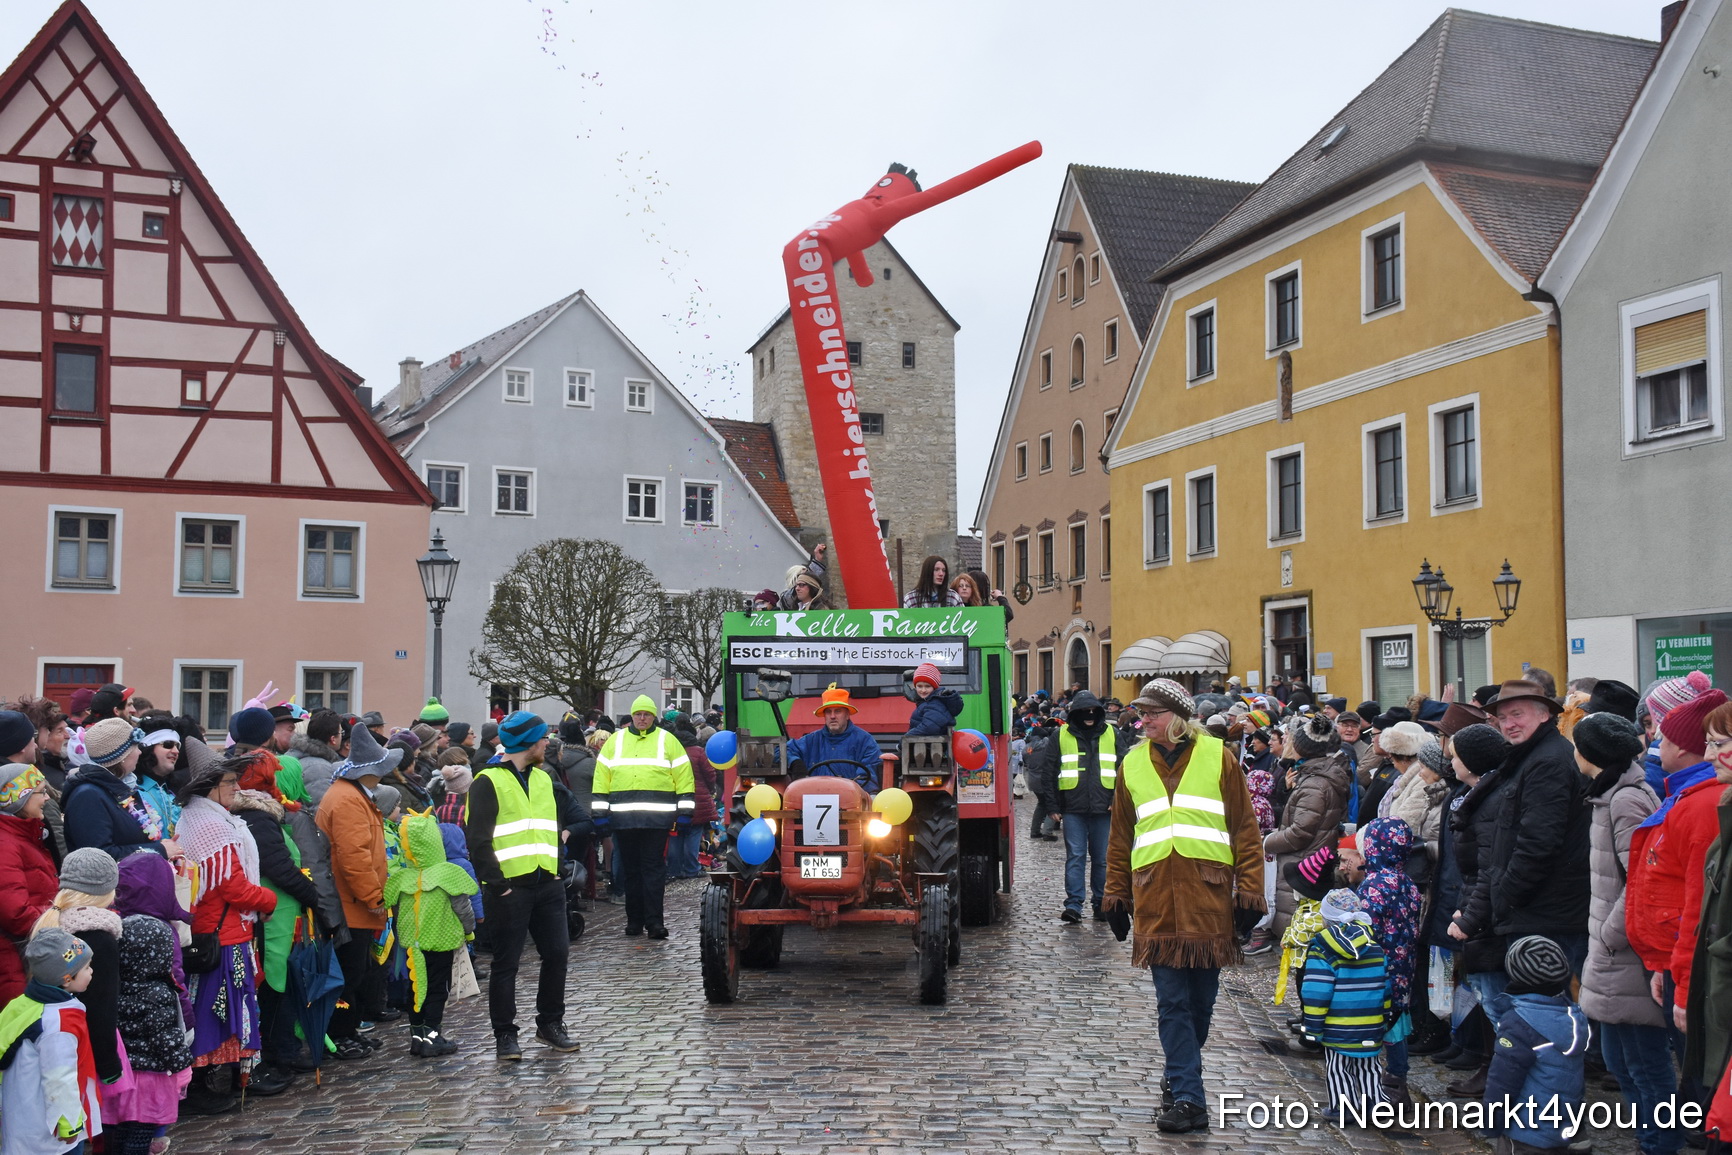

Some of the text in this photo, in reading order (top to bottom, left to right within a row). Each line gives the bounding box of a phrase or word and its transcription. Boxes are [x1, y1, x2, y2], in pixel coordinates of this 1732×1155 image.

[750, 609, 978, 638] The Kelly Family
[1383, 641, 1406, 656] BW
[1656, 636, 1712, 649] ZU VERMIETEN
[732, 647, 761, 658] ESC
[1697, 662, 1713, 670] GmbH
[815, 804, 832, 830] 7
[812, 858, 828, 867] NM
[804, 868, 840, 877] AT 653
